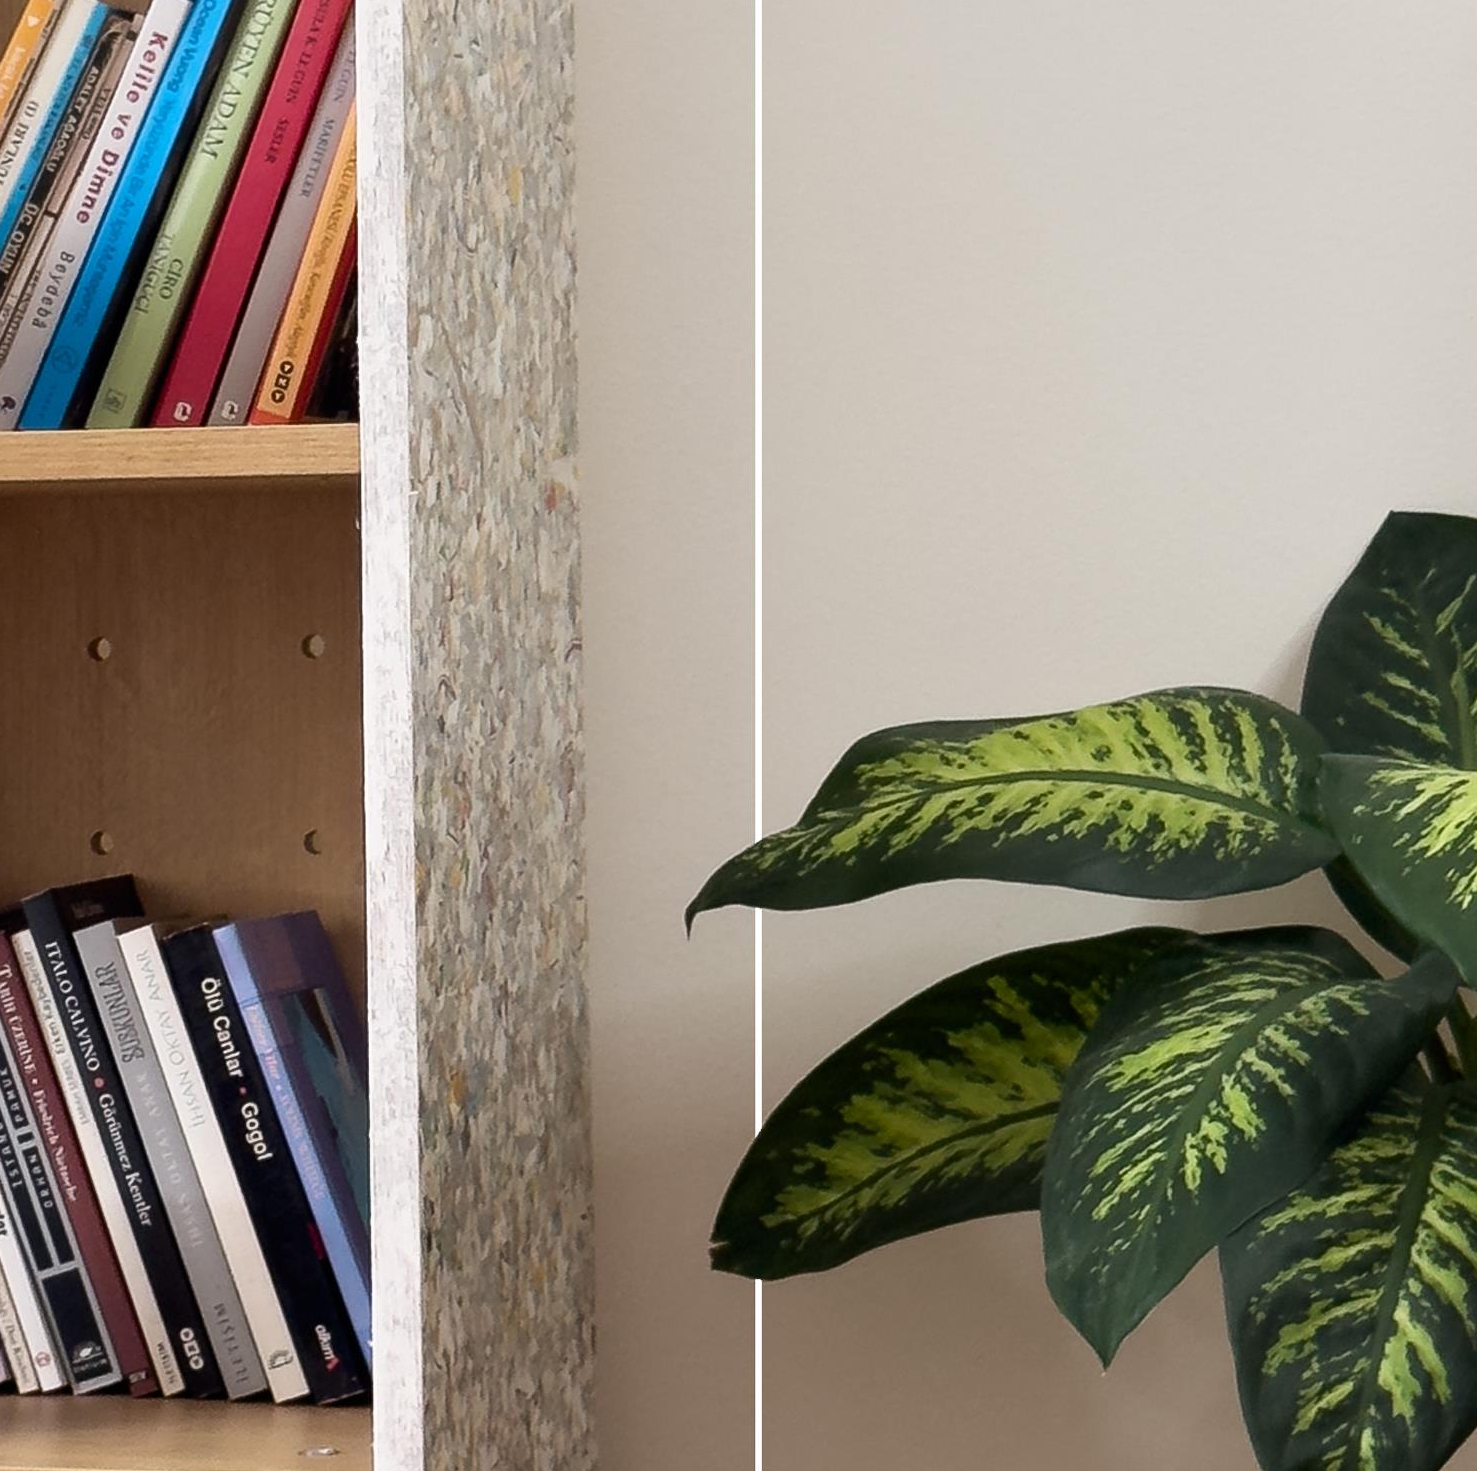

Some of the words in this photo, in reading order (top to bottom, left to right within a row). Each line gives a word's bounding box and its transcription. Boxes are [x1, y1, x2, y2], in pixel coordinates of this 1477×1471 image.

[165, 44, 197, 94] Vuong
[108, 110, 132, 140] ve
[199, 79, 241, 159] ADAM
[76, 149, 119, 225] Dimne
[157, 257, 184, 301] CİRO
[134, 948, 161, 1002] ANAR
[200, 977, 226, 1013] Ölü
[94, 961, 144, 1064] SUSKUNLAR
[155, 1007, 187, 1067] OKTAY
[211, 1014, 243, 1080] Canlar
[45, 941, 72, 995] ITALO
[65, 993, 99, 1072] CALVINO
[98, 1092, 133, 1171] Görünmez
[125, 1171, 153, 1227] Kentler
[239, 1101, 273, 1162] Gogol
[28, 1154, 53, 1209] ORHAN
